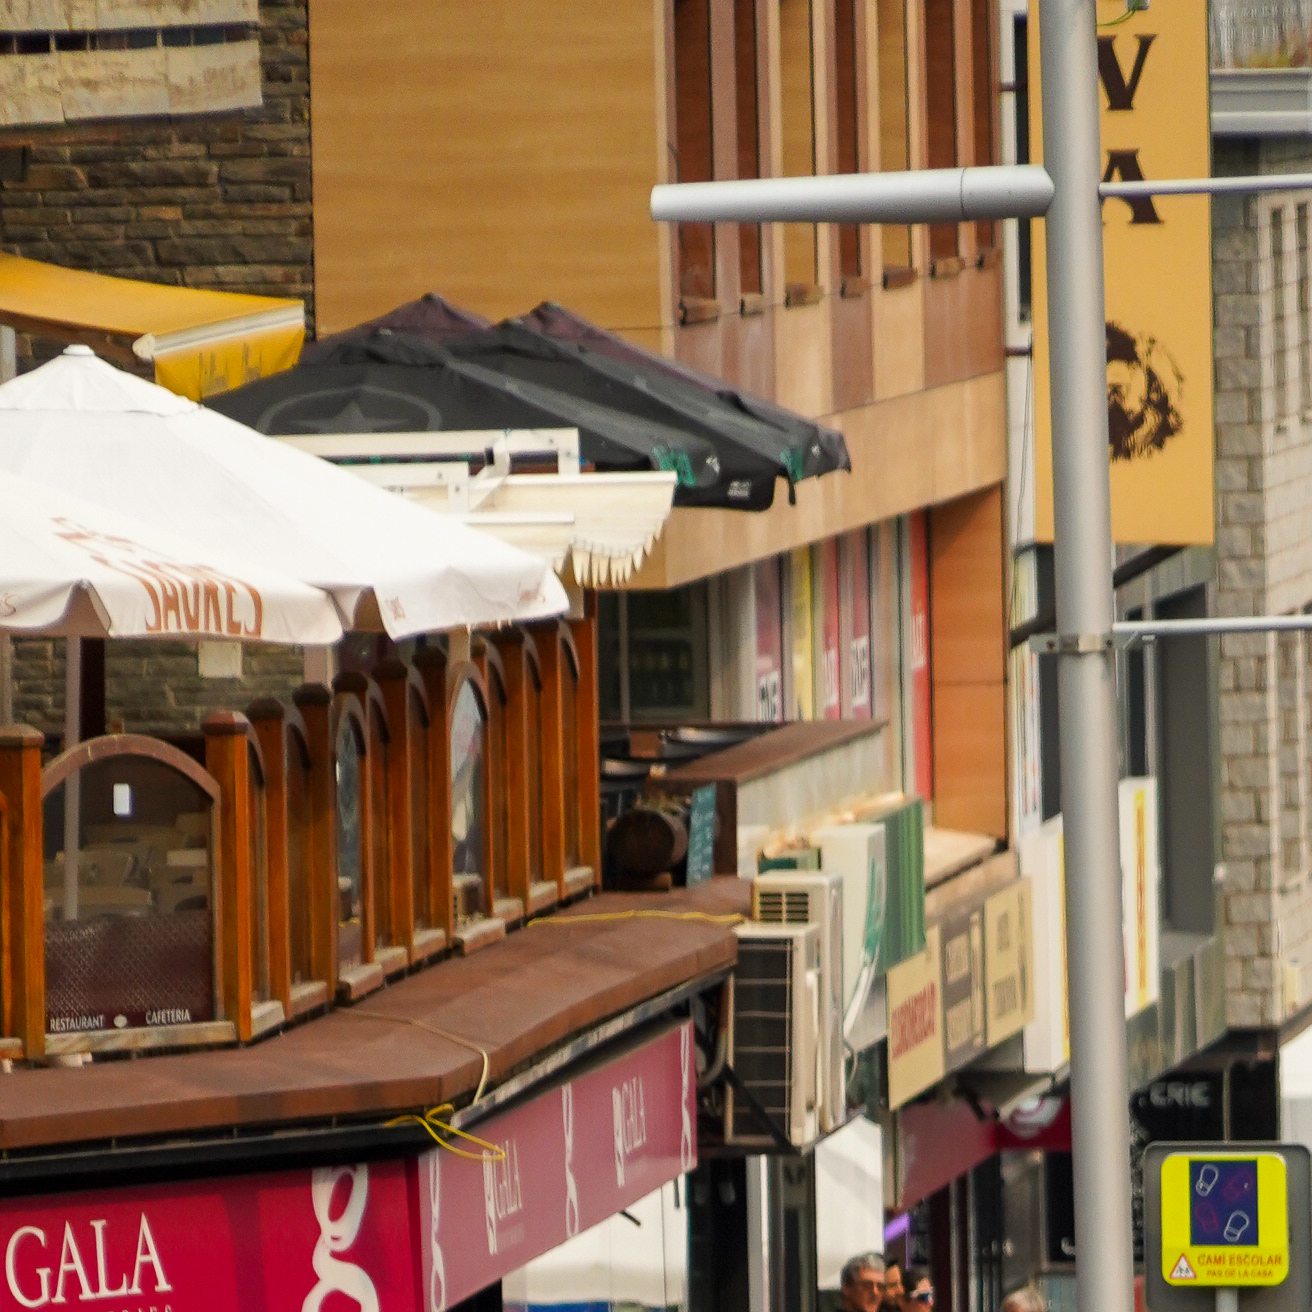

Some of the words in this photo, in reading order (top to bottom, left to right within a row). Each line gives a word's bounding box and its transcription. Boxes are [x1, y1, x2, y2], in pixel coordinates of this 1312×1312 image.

[50, 1014, 104, 1031] RESTAURANT
[145, 1008, 191, 1025] CAFETERIA
[5, 1211, 173, 1309] GALA
[1229, 1253, 1283, 1266] ESCOLAR
